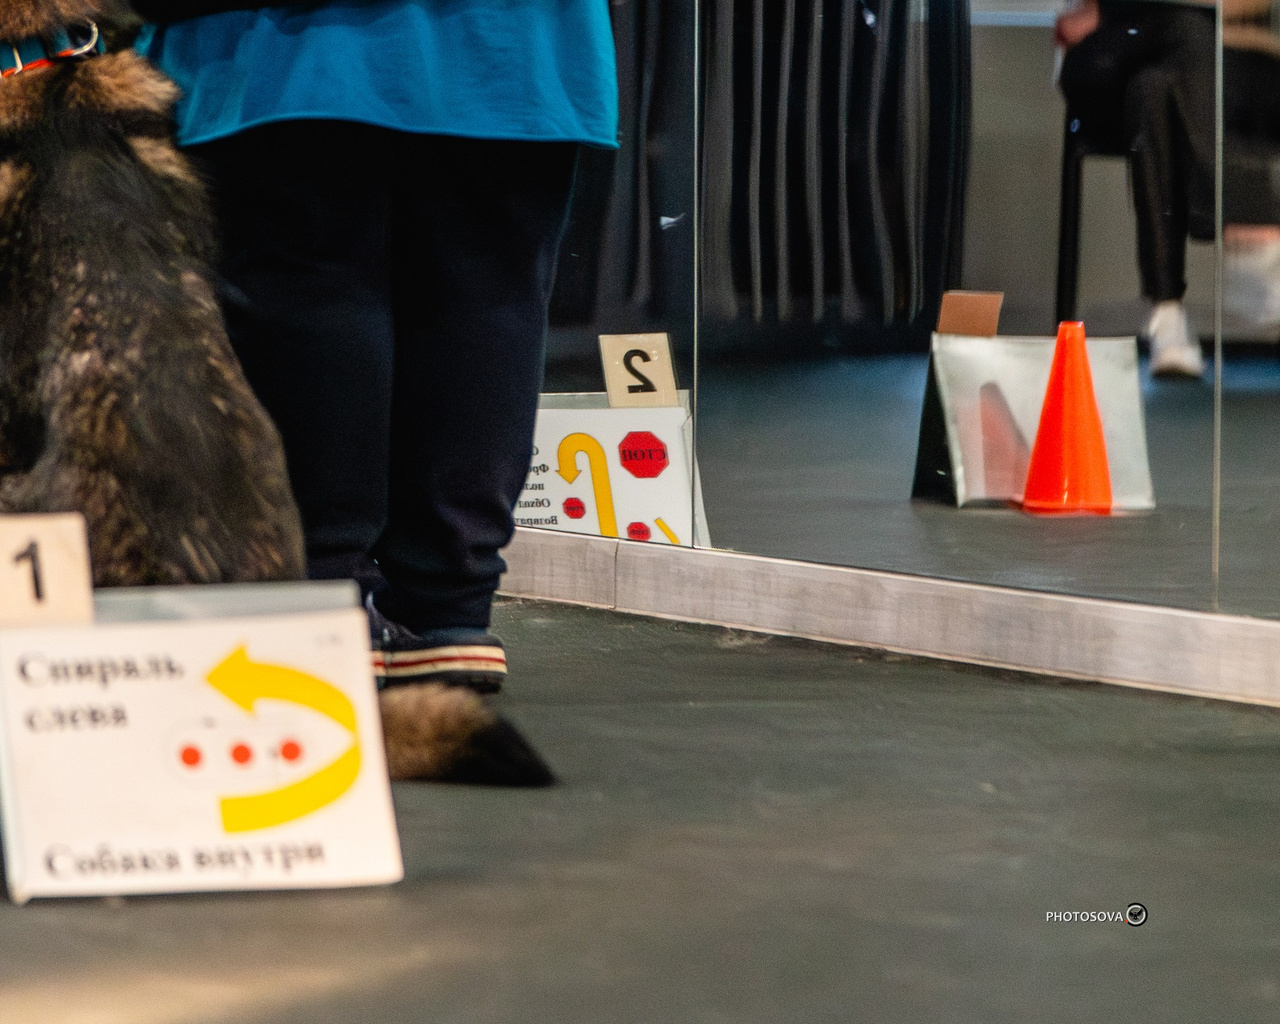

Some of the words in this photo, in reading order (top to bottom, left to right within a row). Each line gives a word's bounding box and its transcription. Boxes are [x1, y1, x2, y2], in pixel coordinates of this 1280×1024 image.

[13, 540, 46, 604] 1
[18, 651, 184, 689] Спираль
[43, 842, 182, 878] Собака
[192, 840, 326, 878] внутри
